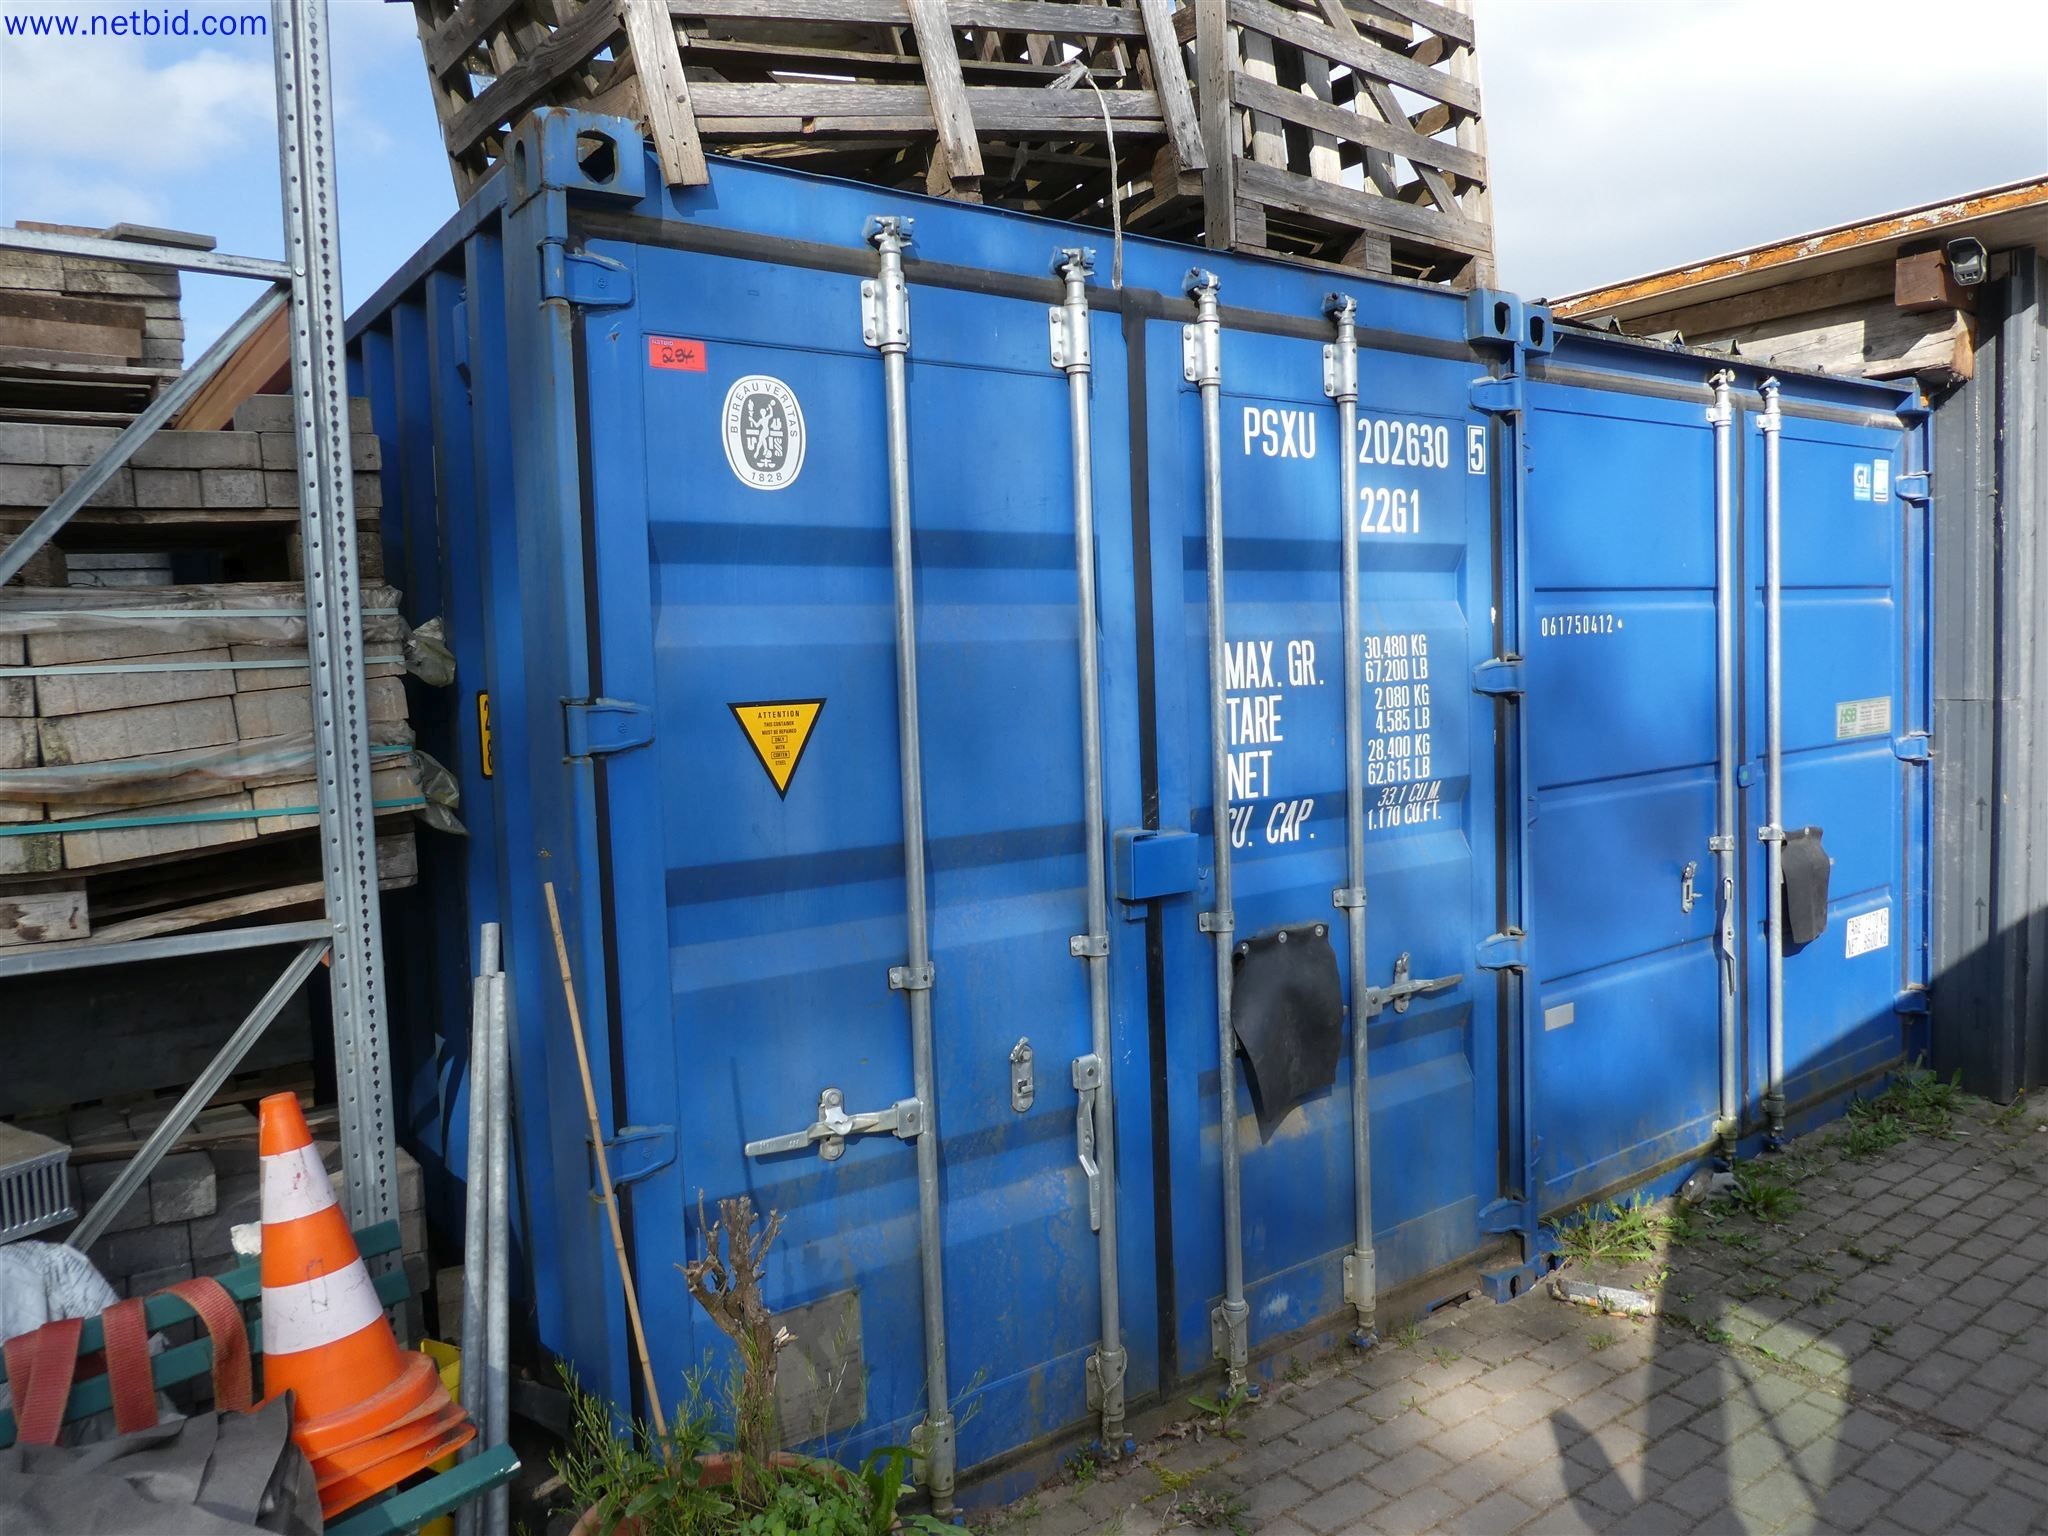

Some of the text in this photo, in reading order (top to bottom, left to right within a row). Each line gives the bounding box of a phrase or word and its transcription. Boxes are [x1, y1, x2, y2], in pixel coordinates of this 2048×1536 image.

[729, 382, 799, 438] BUREAU VERITAS
[1243, 406, 1316, 459] PSXU
[1357, 417, 1484, 472] 202630 5
[751, 471, 783, 483] 1828
[1360, 487, 1421, 534] 22G1
[1541, 613, 1613, 637] 061750412
[1411, 634, 1427, 657] KG
[1225, 640, 1325, 690] MAX. GR.
[1413, 657, 1429, 680] LB
[1414, 684, 1430, 707] KG
[758, 710, 800, 719] ATTENTION
[1226, 694, 1284, 746] TARE
[1414, 707, 1430, 730] LB
[1415, 733, 1431, 756] KG
[1228, 750, 1273, 801] NET
[1415, 756, 1431, 779] LB
[1266, 799, 1316, 844] CAP.
[1404, 800, 1441, 824] CU.FT.
